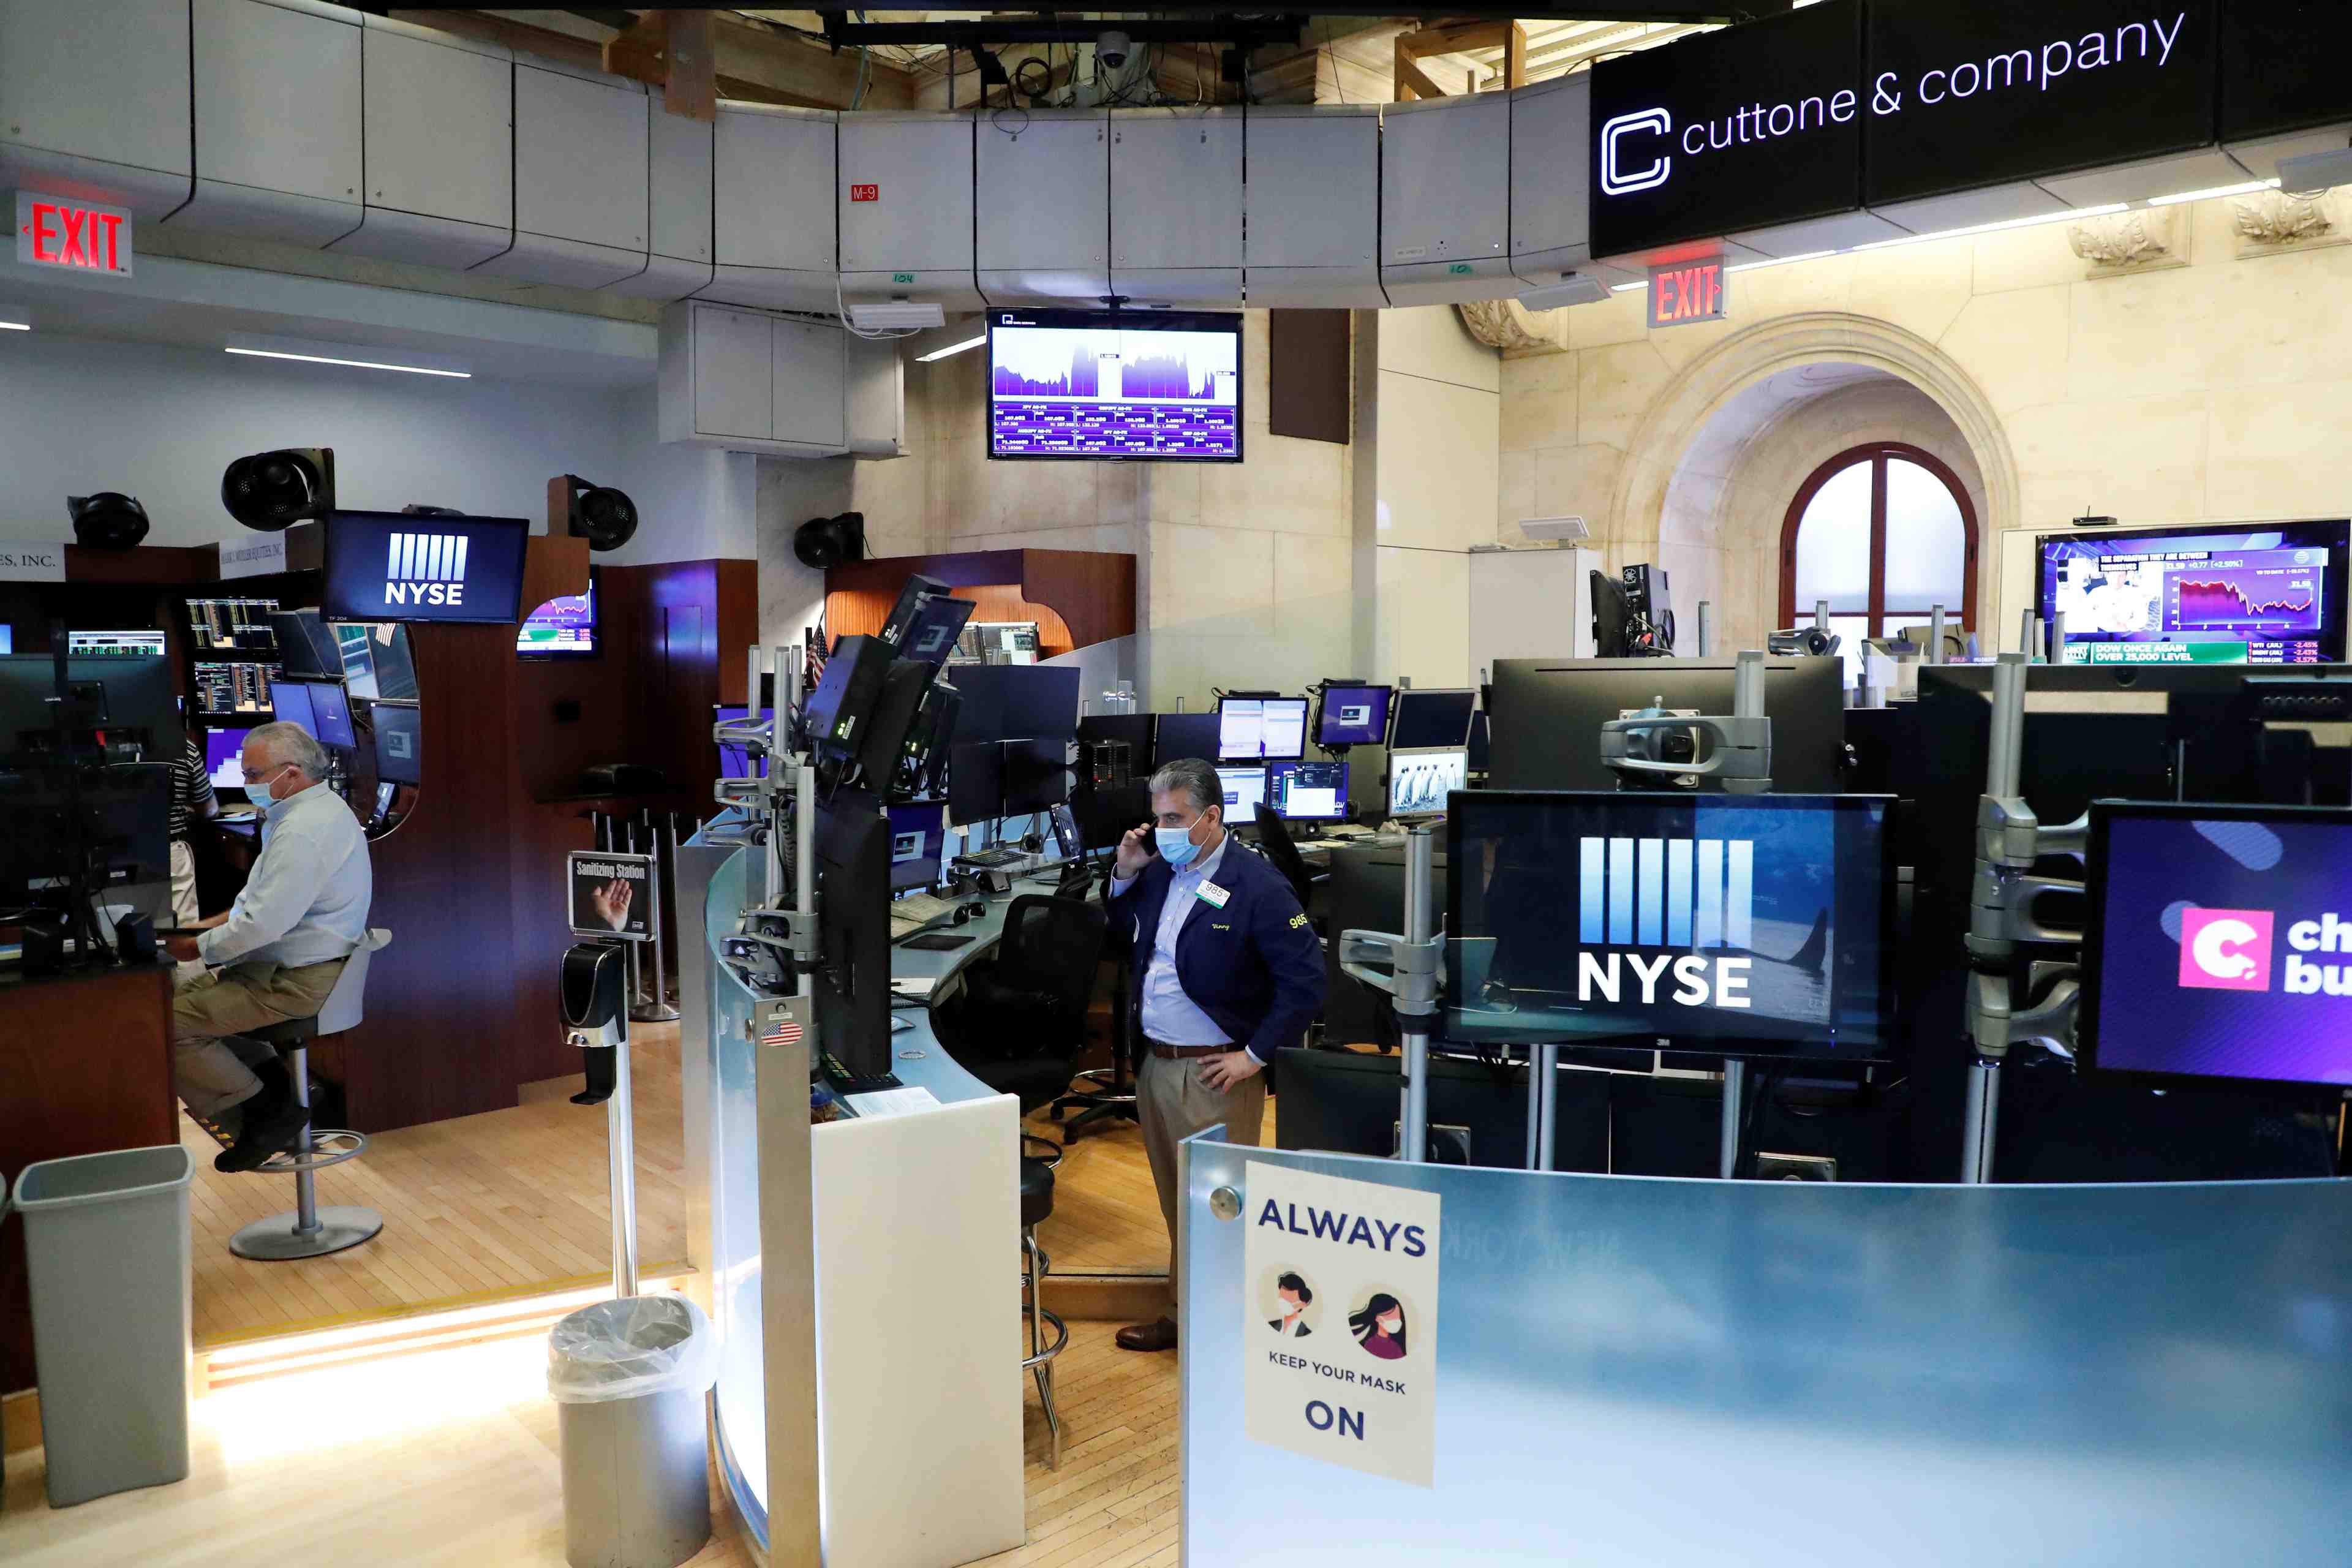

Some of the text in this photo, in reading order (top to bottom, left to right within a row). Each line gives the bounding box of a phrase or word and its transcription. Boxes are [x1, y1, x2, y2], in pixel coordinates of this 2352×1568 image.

[1682, 11, 2185, 156] cuttone & company
[854, 186, 875, 200] M-9
[32, 202, 123, 270] EXIT
[1656, 265, 1718, 322] EXIT
[22, 555, 56, 567] INC.
[385, 582, 464, 605] NYSE
[2123, 644, 2151, 652] ONCE
[2154, 644, 2187, 652] AGAIN
[2125, 653, 2159, 662] 25,000
[2162, 652, 2193, 661] LEVEL
[577, 861, 646, 879] Sanitizing Station
[1205, 883, 1224, 897] 985
[1289, 913, 1308, 929] 985
[1578, 951, 1753, 1009] NYSE
[1258, 1198, 1427, 1257] ALWAYS
[1269, 1350, 1406, 1395] KEEP YOUR MASK
[1305, 1400, 1364, 1441] ON
